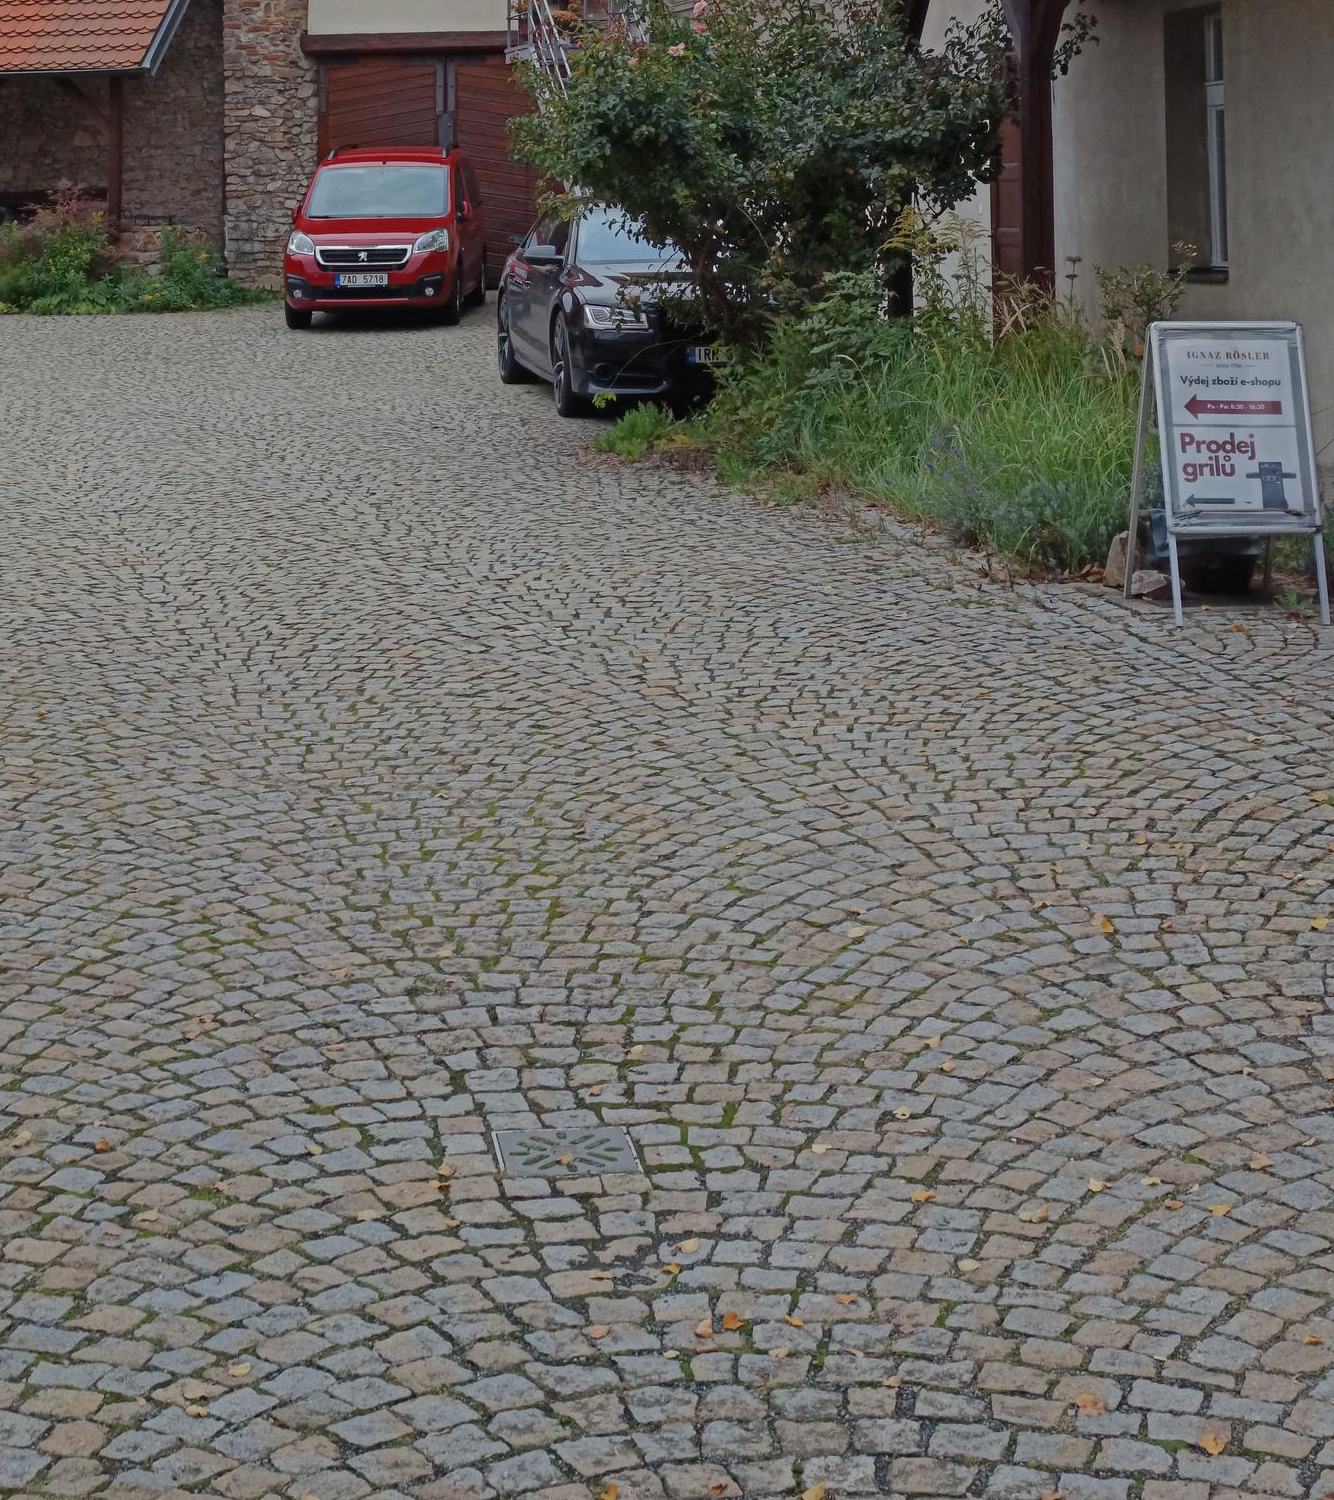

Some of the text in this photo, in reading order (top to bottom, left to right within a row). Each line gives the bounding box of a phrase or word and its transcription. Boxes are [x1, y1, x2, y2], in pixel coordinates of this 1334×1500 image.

[363, 274, 384, 284] 5718
[1187, 350, 1270, 360] IGNAZ RÖSLER
[1180, 375, 1281, 388] Výdej zboží e-shopu
[1180, 432, 1255, 460] Prodej
[1182, 455, 1236, 483] grilů
